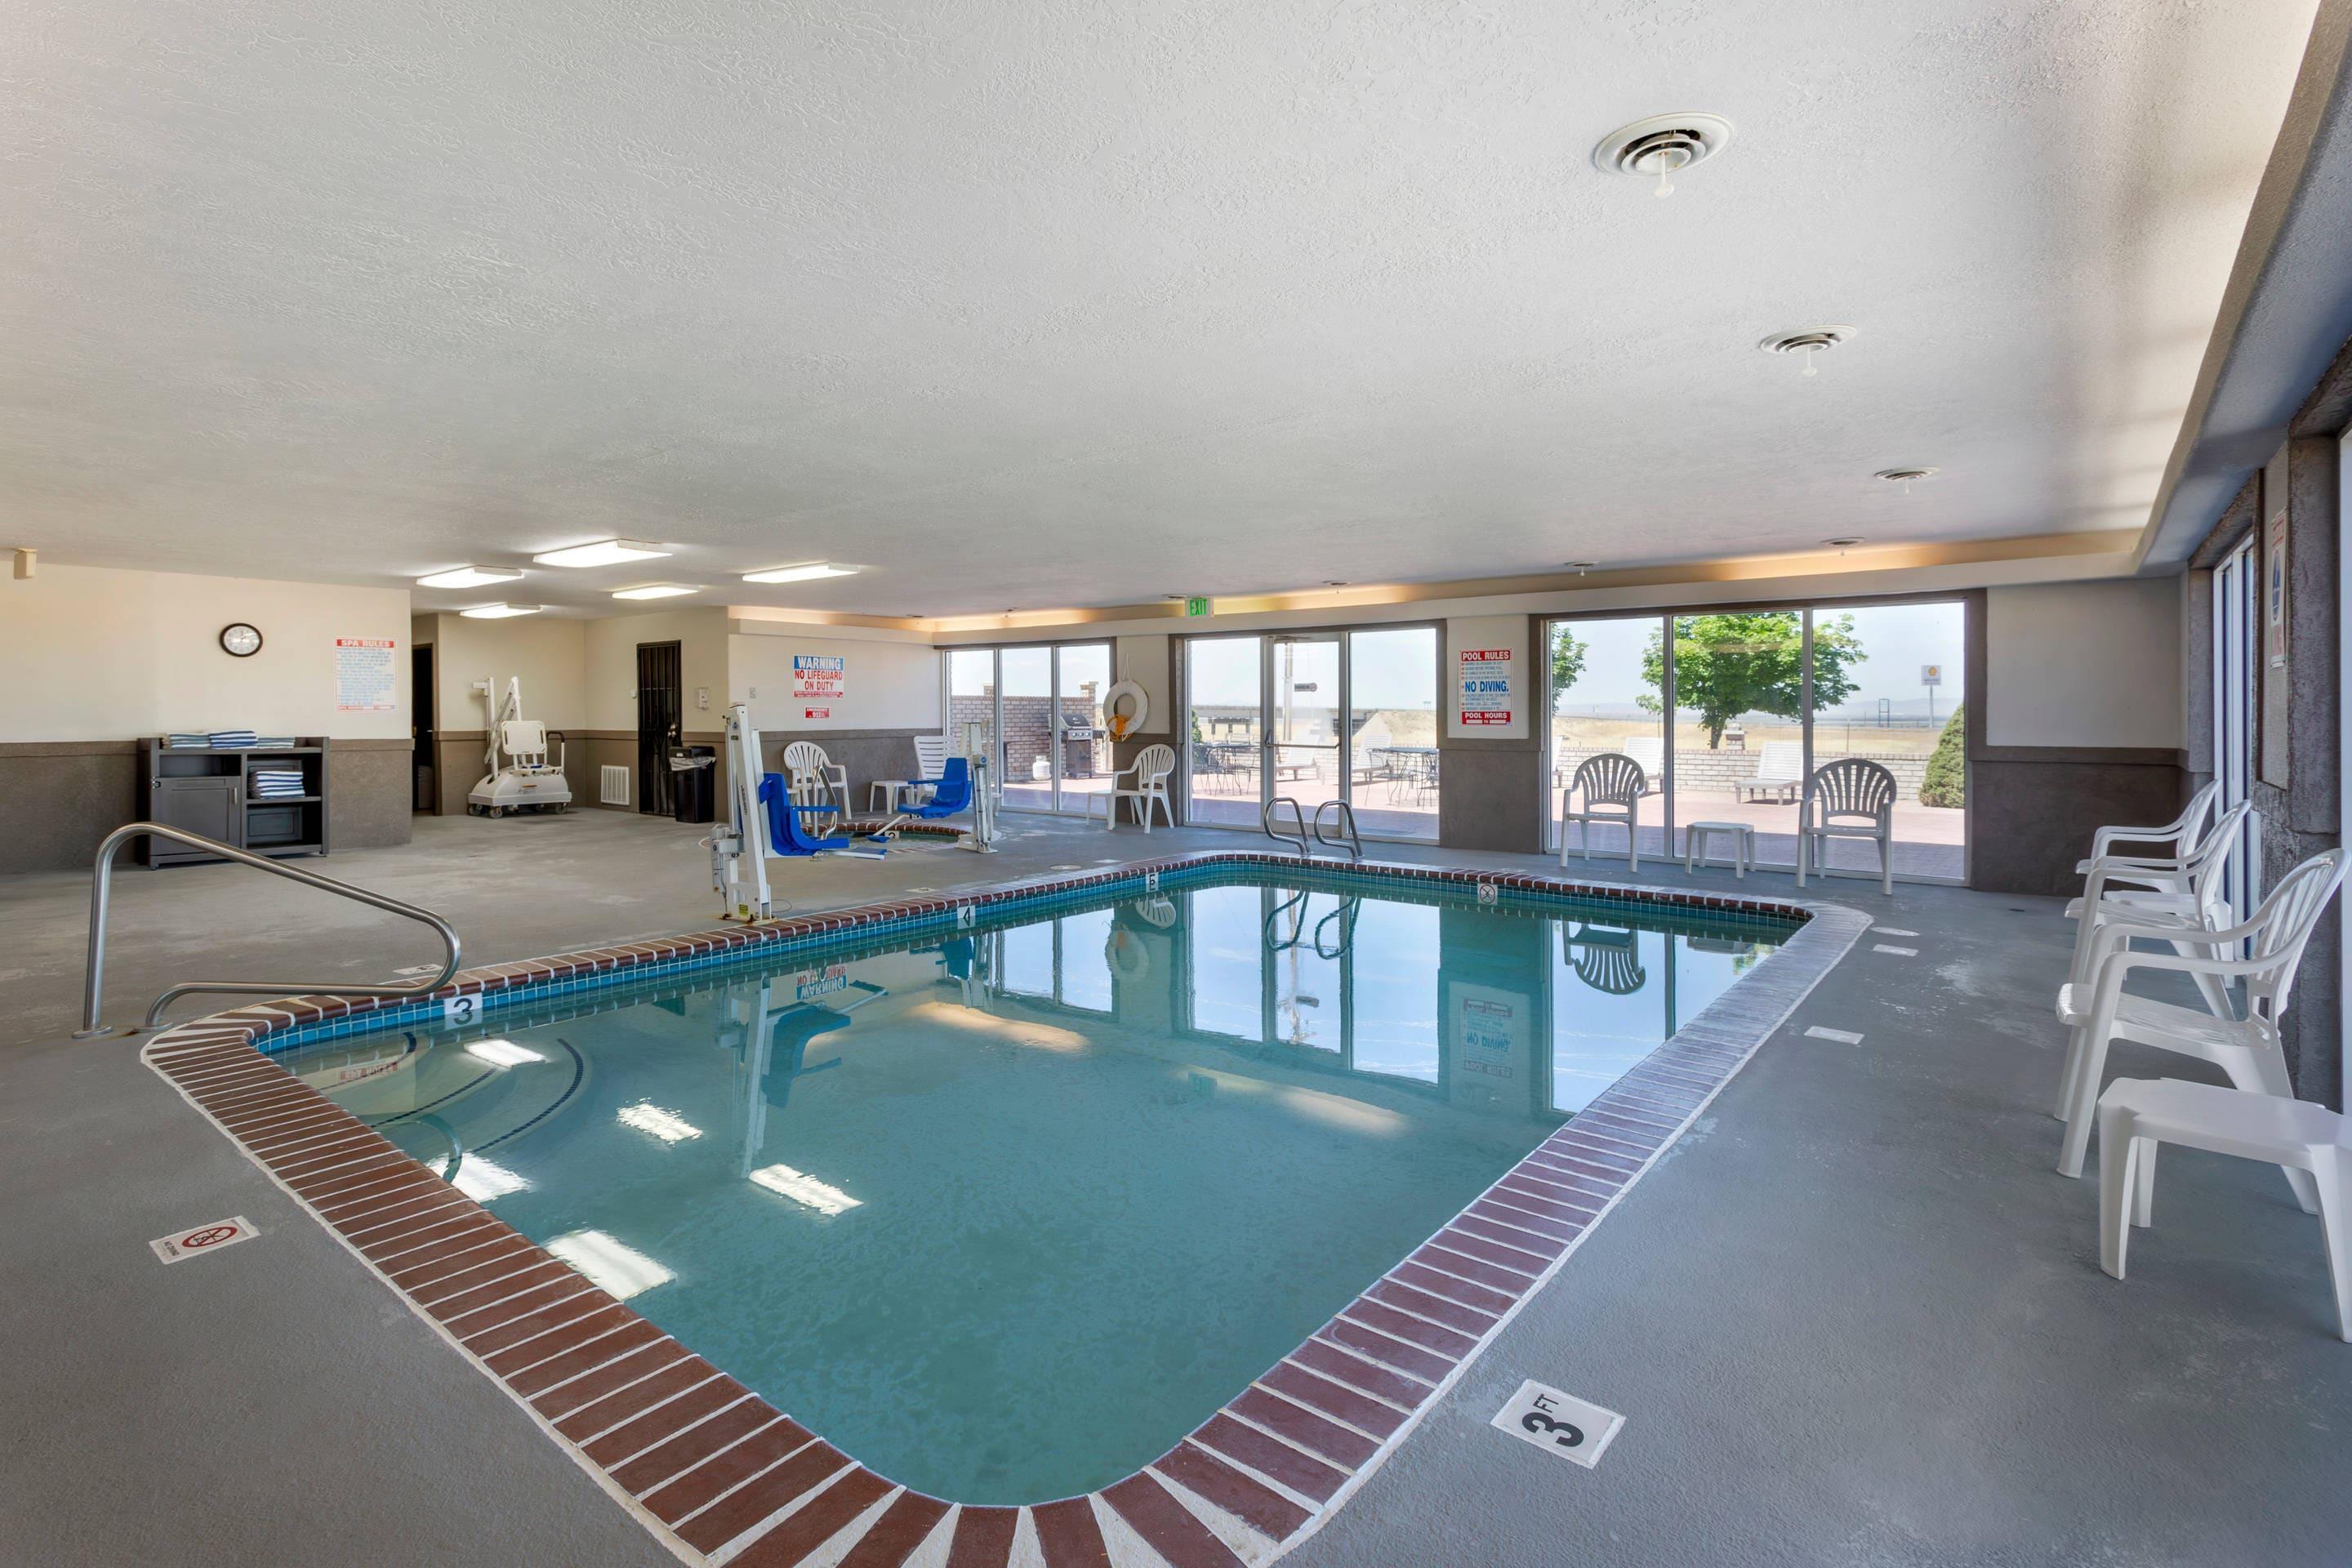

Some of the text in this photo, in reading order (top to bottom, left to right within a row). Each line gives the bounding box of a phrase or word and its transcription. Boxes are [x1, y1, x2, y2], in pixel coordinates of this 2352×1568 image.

[1189, 598, 1207, 616] EXIT
[1463, 651, 1509, 660] POOL RULES
[798, 657, 841, 670] WARNING
[795, 670, 842, 679] NO LIFEGUARD
[804, 681, 834, 690] ON DUTY
[1465, 679, 1509, 693] NO DIVING.
[1521, 1393, 1584, 1447] 3 FT
